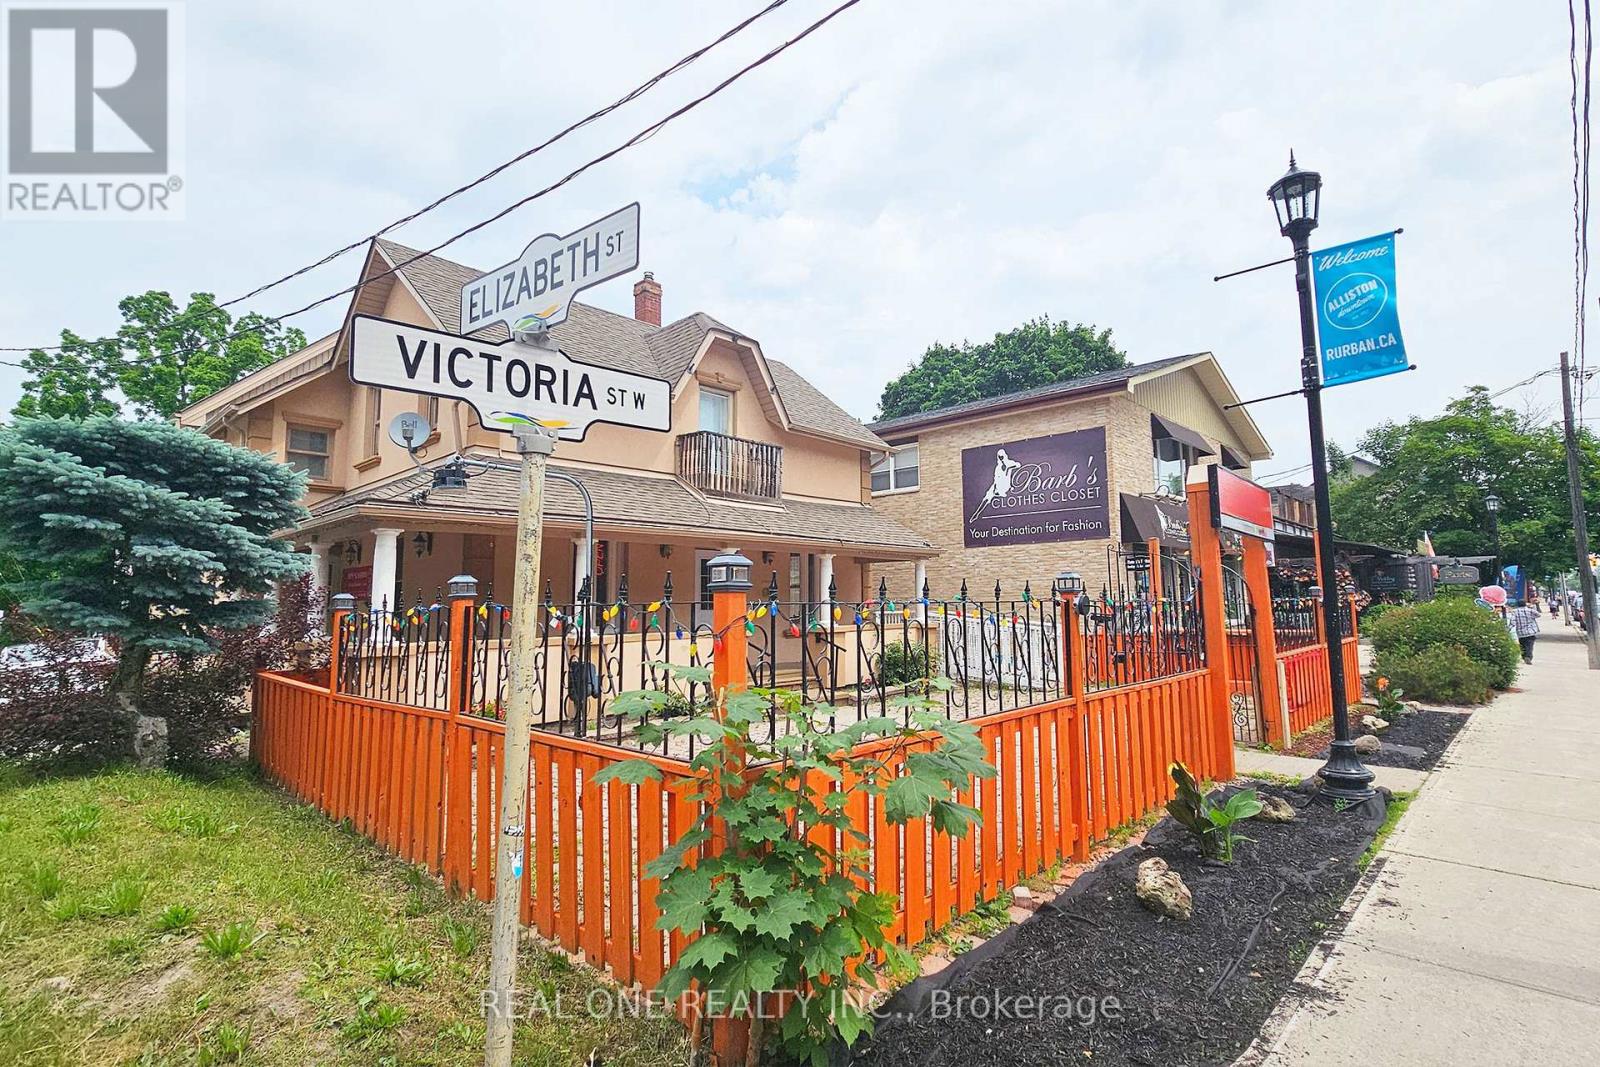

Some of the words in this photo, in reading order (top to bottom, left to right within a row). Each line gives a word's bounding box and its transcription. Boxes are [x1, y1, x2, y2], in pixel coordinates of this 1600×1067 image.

[1318, 246, 1390, 272] Welcome
[469, 232, 600, 324] ELIZABETH
[606, 230, 624, 257] ST
[1328, 279, 1379, 313] ALLISTON
[1326, 332, 1397, 361] RURBAN.CA
[396, 335, 598, 410] VICTORIA
[606, 387, 627, 406] ST
[633, 391, 646, 410] W
[991, 492, 1045, 509] CLOTHES
[1050, 486, 1101, 503] CLOSET
[969, 528, 989, 539] Your
[991, 522, 1043, 538] Destination
[1045, 521, 1060, 533] for
[1062, 519, 1102, 532] Fashion
